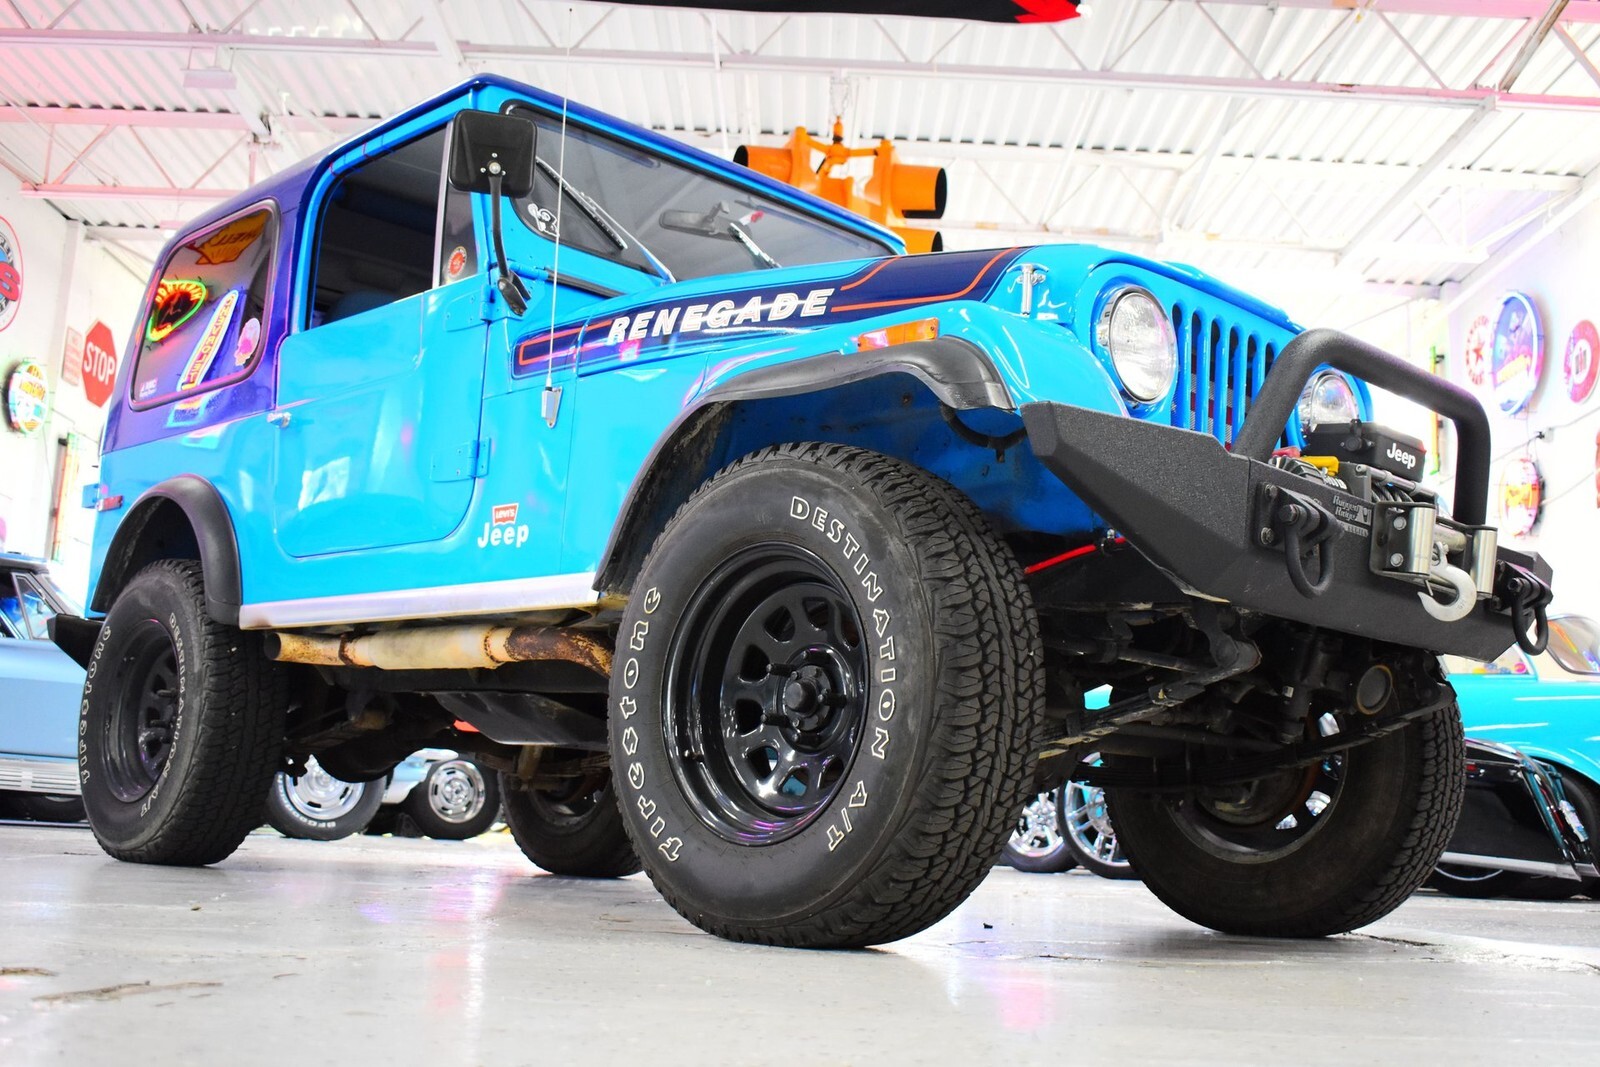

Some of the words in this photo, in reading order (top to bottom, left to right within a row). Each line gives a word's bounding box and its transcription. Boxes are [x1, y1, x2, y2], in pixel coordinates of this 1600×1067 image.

[606, 288, 835, 345] RENEGADE
[84, 342, 115, 385] STOP
[1386, 442, 1416, 469] Jeep
[477, 522, 529, 548] Jeep
[790, 496, 896, 759] DESTINATION
[827, 780, 867, 851] A/T
